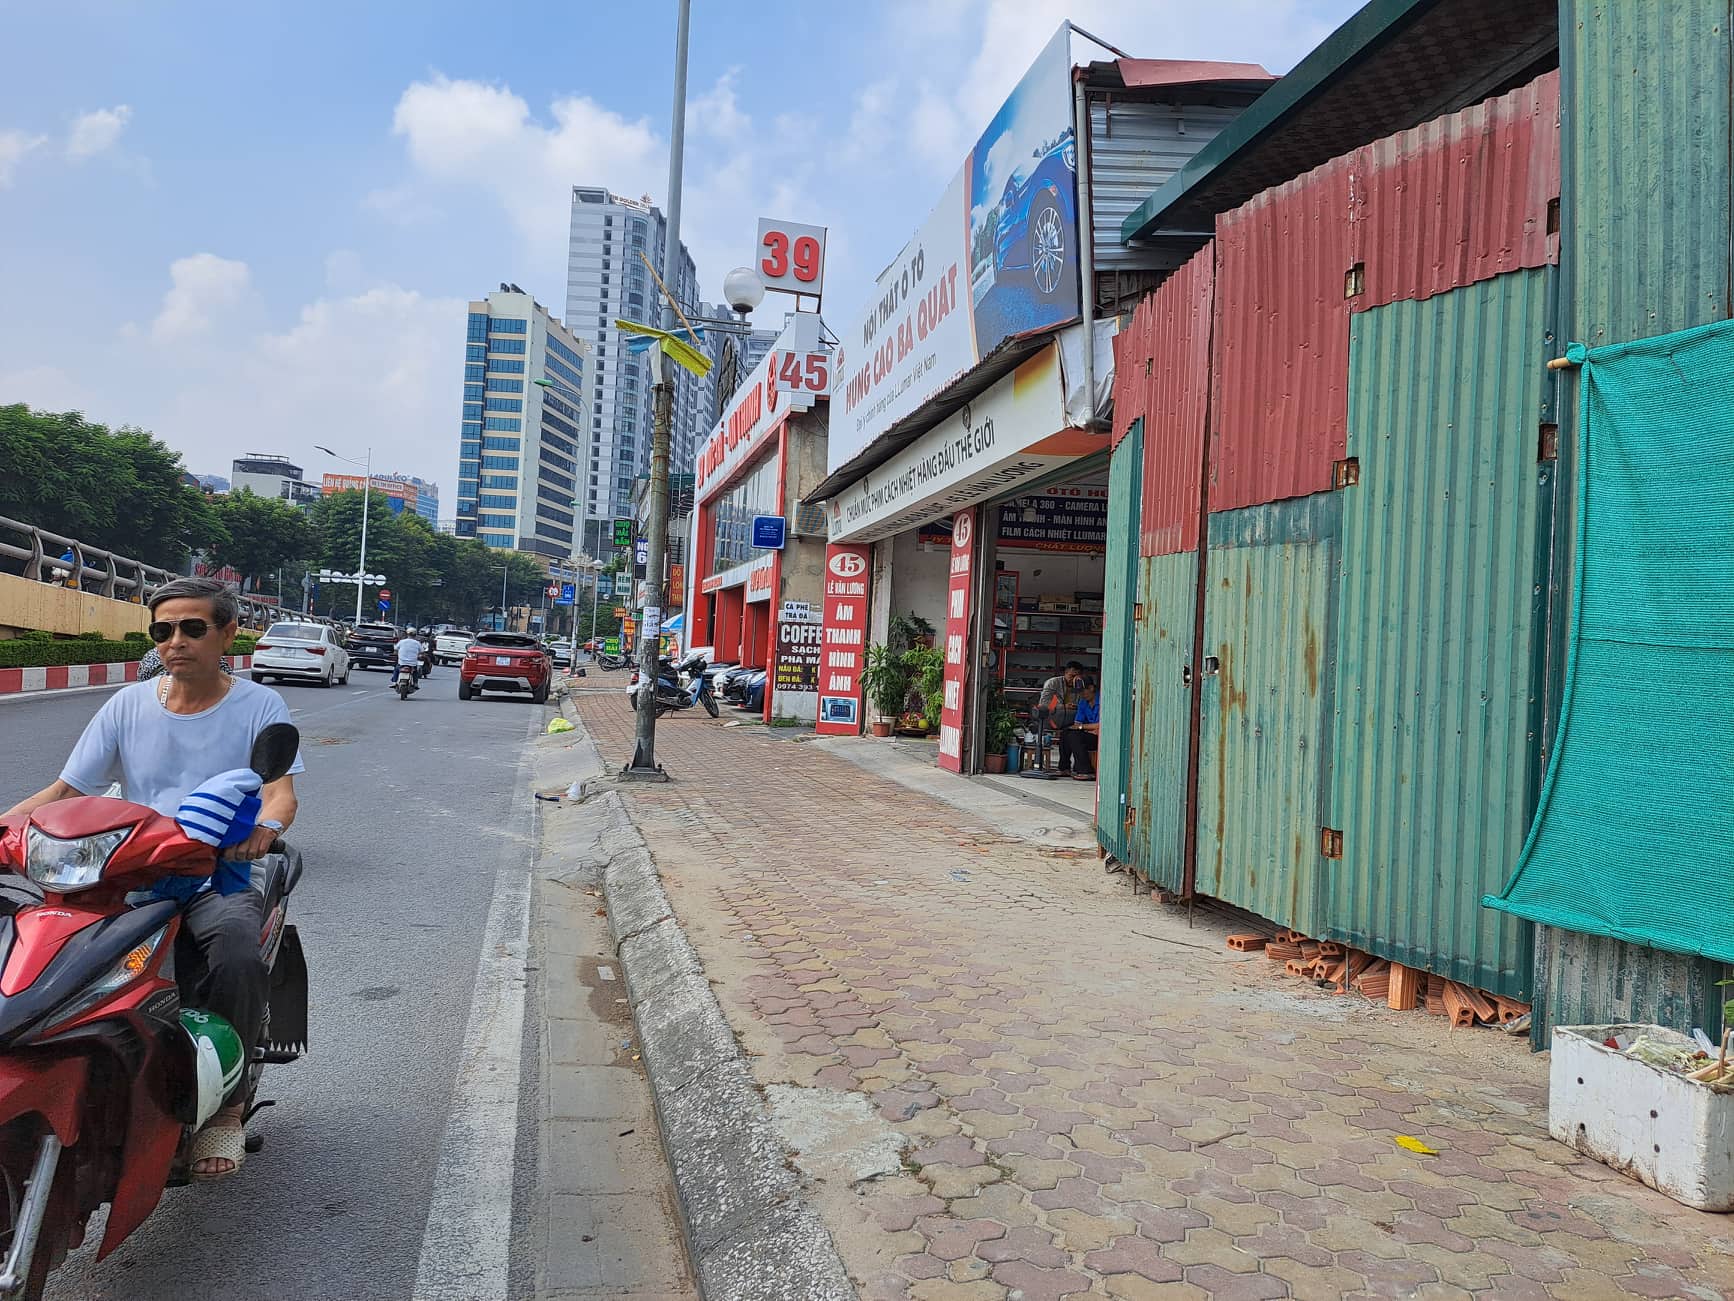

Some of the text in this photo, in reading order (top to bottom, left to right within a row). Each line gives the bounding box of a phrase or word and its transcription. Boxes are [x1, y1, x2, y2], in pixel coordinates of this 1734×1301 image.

[762, 231, 820, 283] 39
[873, 336, 894, 387] CAO
[897, 305, 914, 363] BÁ
[917, 261, 957, 342] QUÁT
[779, 351, 828, 392] 45
[884, 478, 898, 504] CÁCH
[917, 455, 937, 486] HÀNG
[974, 415, 995, 453] GIỚI
[1040, 500, 1056, 510] 360
[1065, 501, 1100, 512] CAMERA
[955, 516, 969, 542] 45
[1002, 526, 1022, 538] FILM
[1023, 526, 1046, 539] CÁCH
[1047, 528, 1072, 541] NHIỆT
[836, 556, 860, 571] 45
[836, 602, 853, 621] ÂM
[826, 628, 861, 645] THANH
[781, 655, 803, 664] PHA
[828, 649, 855, 668] HÌNH
[829, 672, 852, 692] ẢNH
[148, 991, 177, 1014] HONDA
